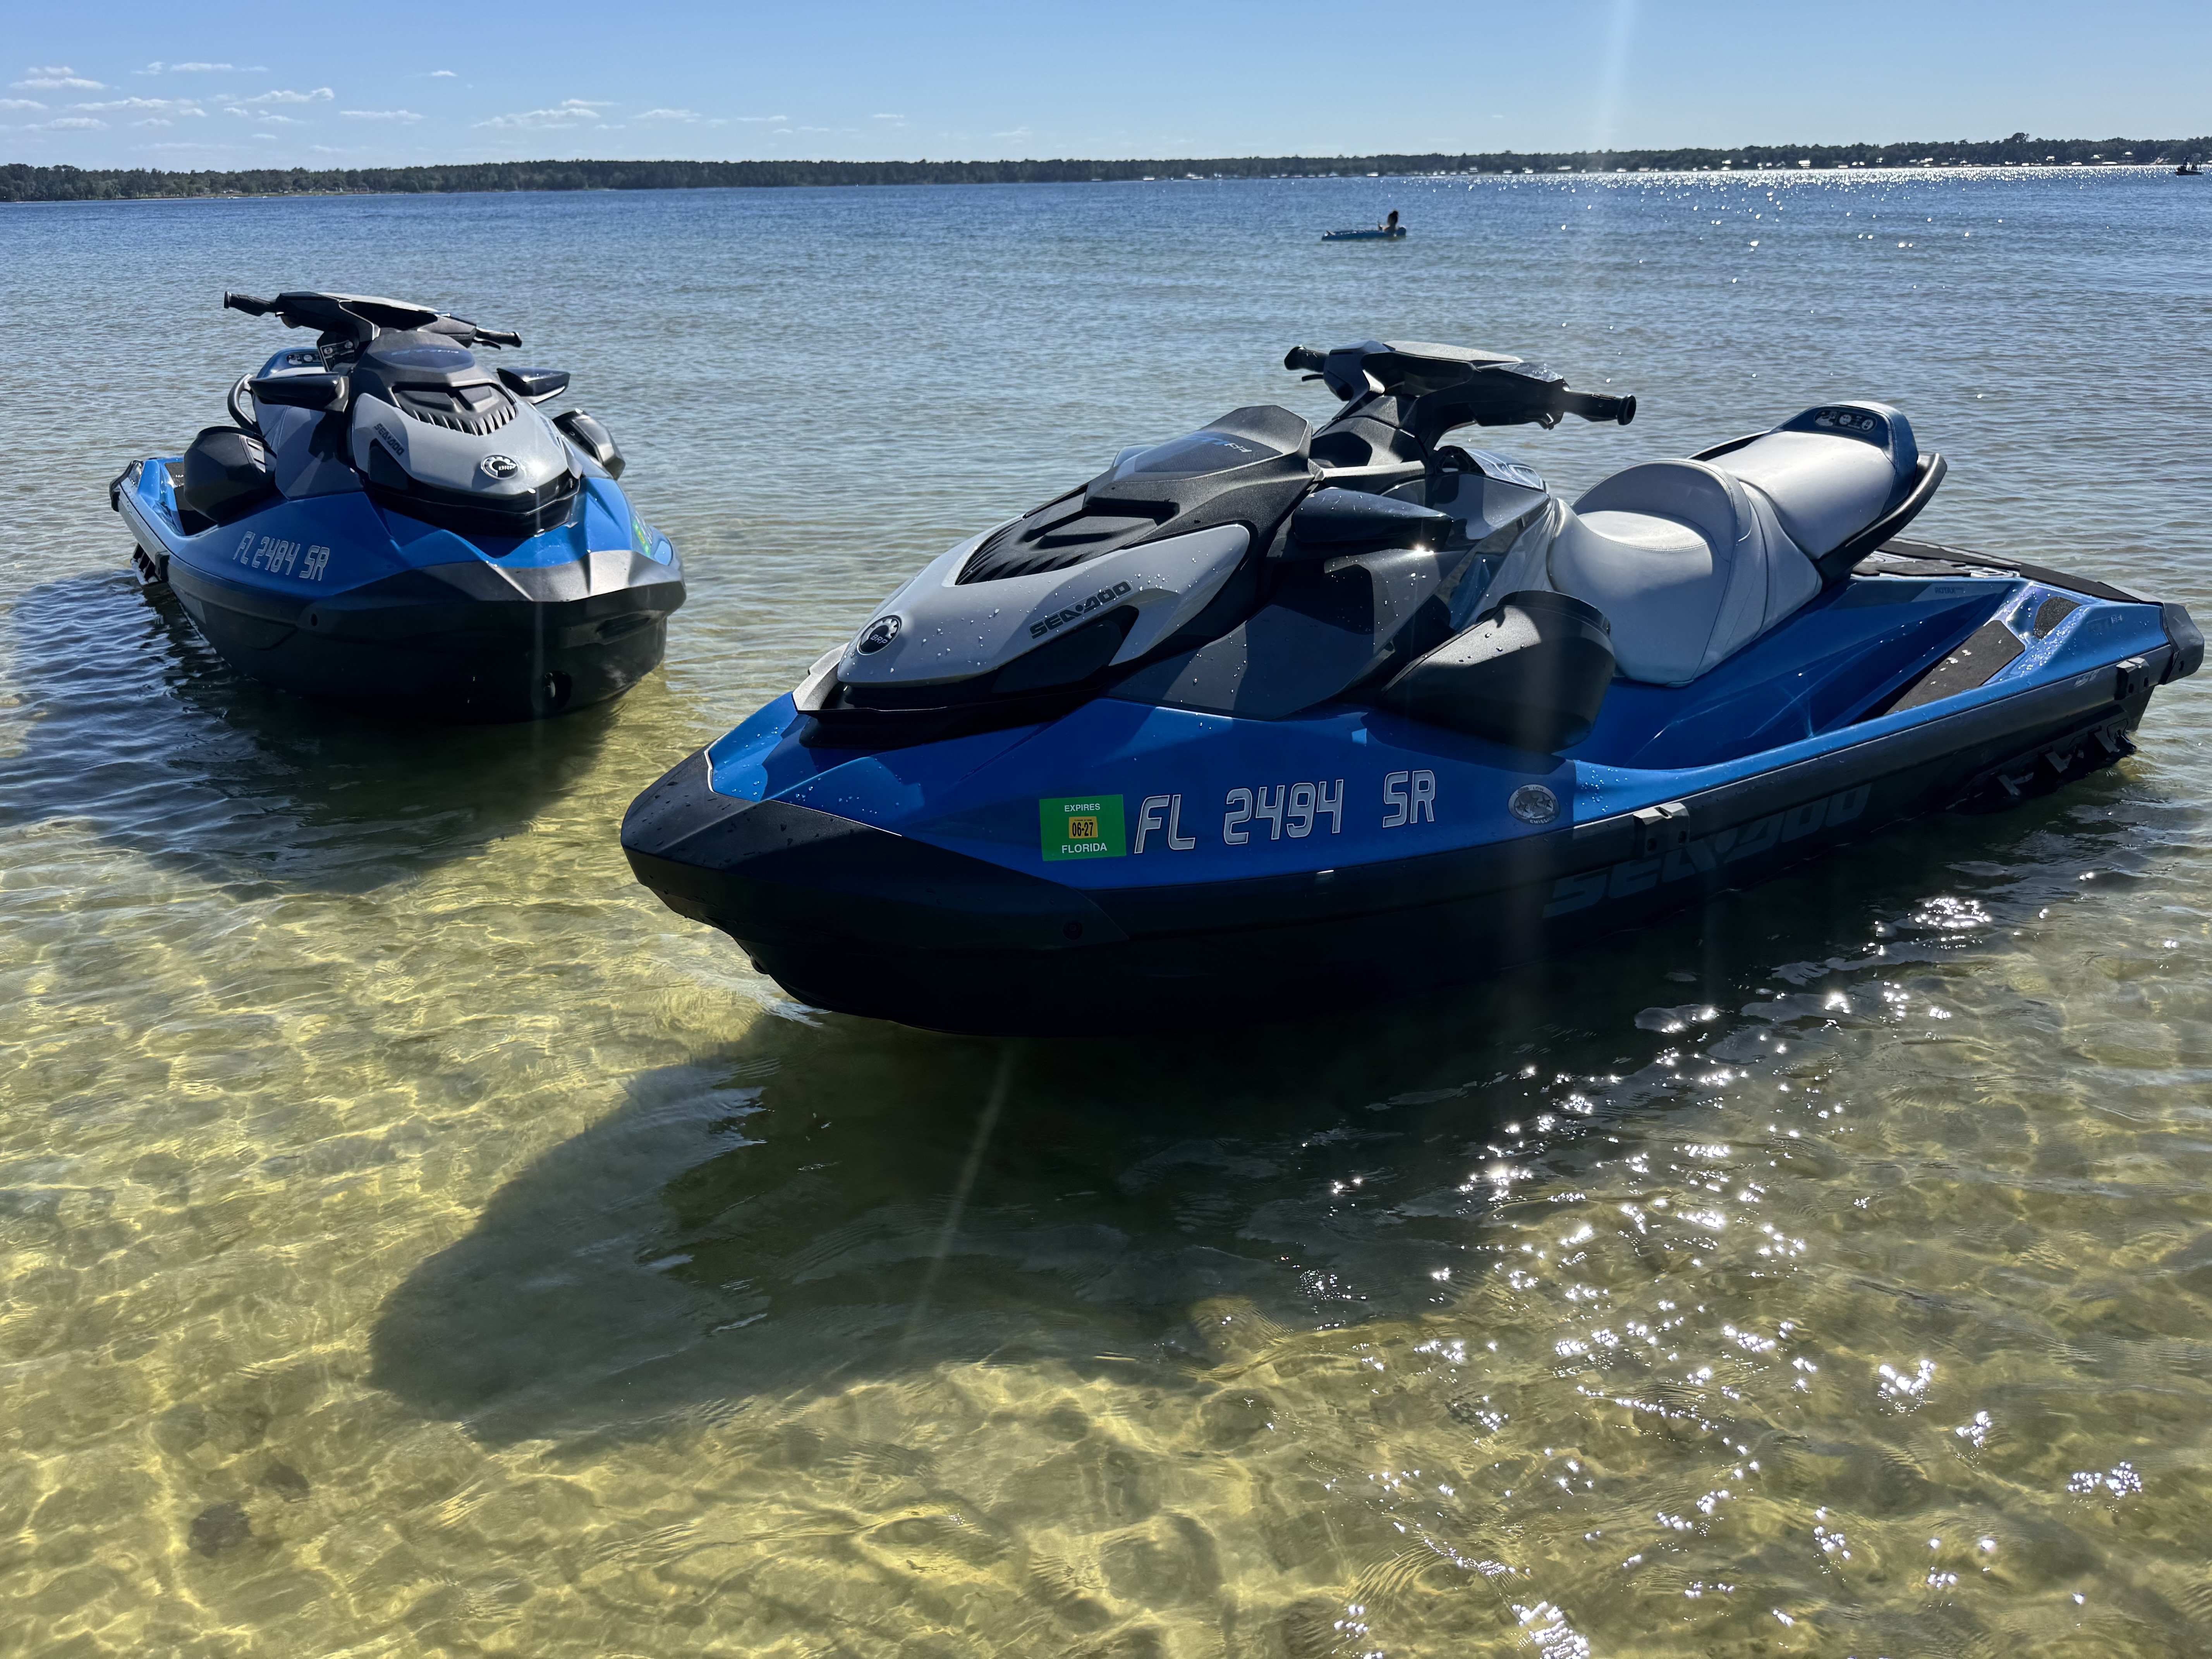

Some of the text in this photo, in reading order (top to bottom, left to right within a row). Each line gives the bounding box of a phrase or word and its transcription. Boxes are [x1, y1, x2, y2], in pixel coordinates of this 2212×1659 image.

[233, 531, 330, 581] FL 2484 SR
[870, 634, 888, 644] BRP
[1065, 803, 1100, 812] EXPIRES
[1133, 769, 1436, 854] FL 2494 SR
[1061, 843, 1108, 854] FLORIDA
